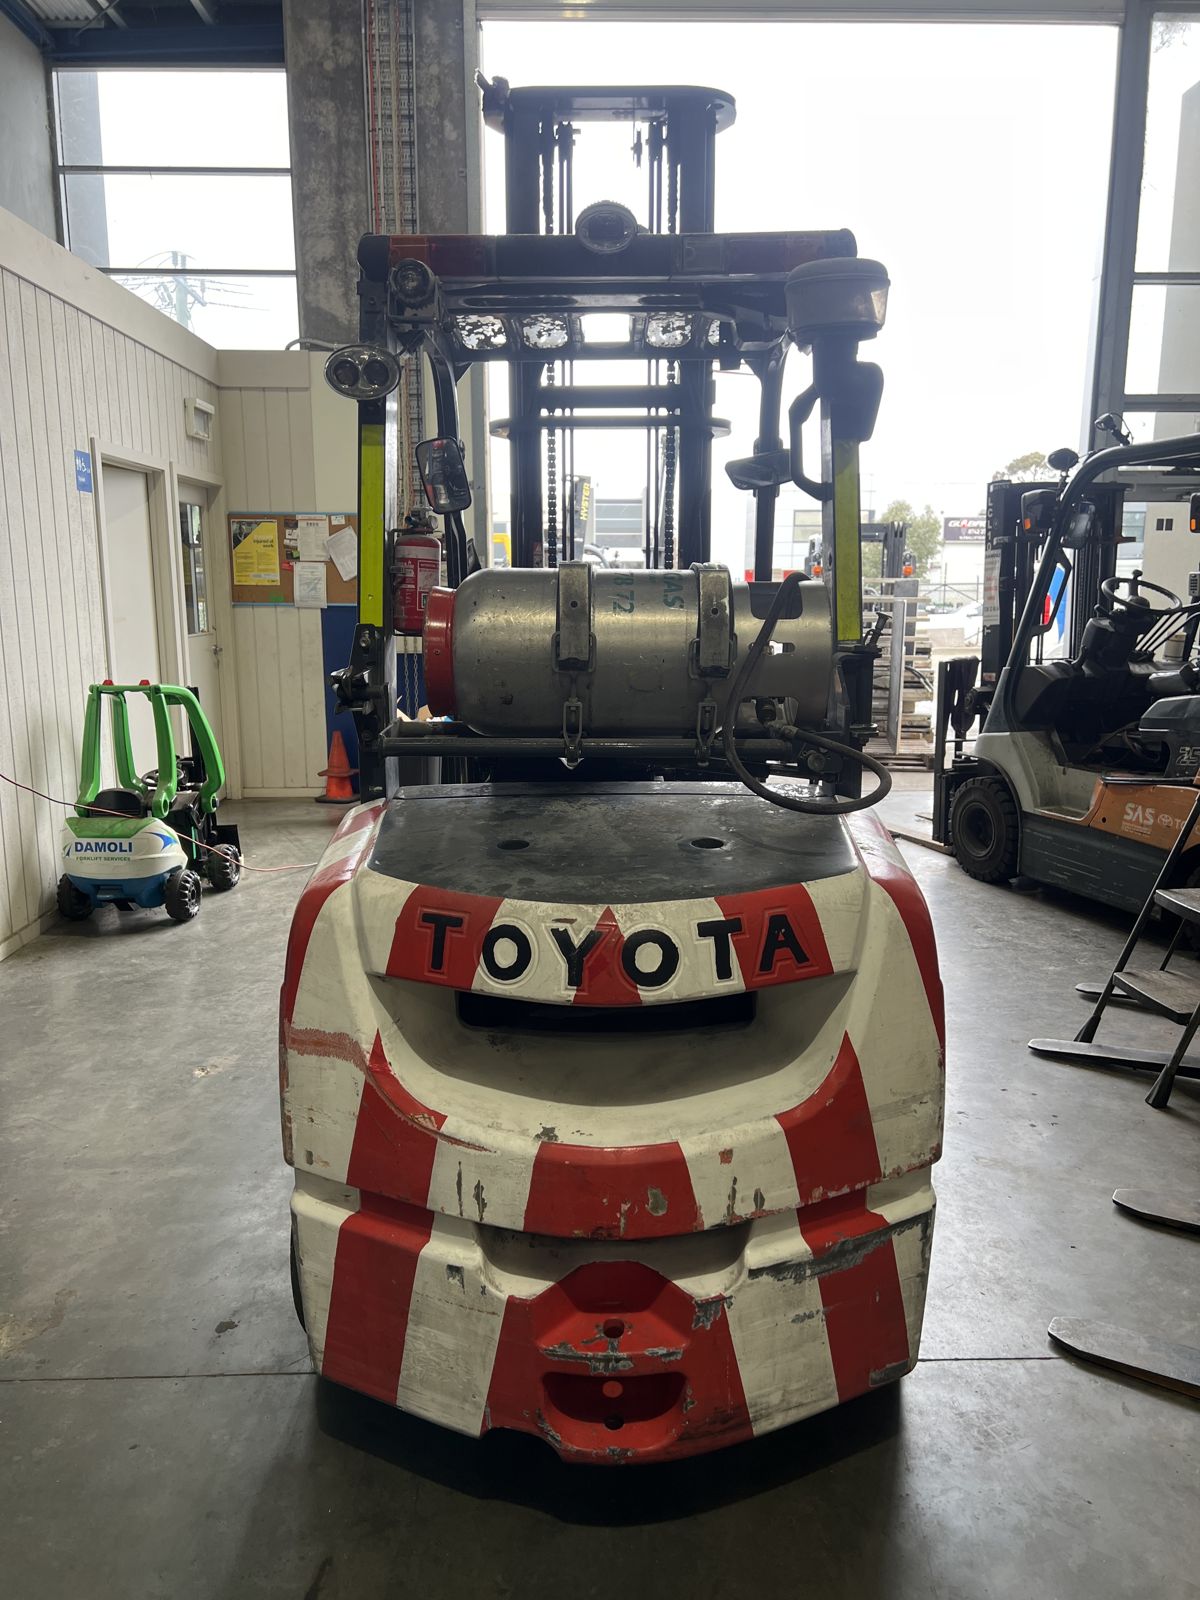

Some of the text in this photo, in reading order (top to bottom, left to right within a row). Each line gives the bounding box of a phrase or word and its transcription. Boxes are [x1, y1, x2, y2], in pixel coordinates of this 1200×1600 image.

[580, 483, 590, 520] HYSTER
[1123, 802, 1155, 826] SAS
[75, 842, 132, 852] DAMOLI
[418, 909, 814, 990] TOYOTA
